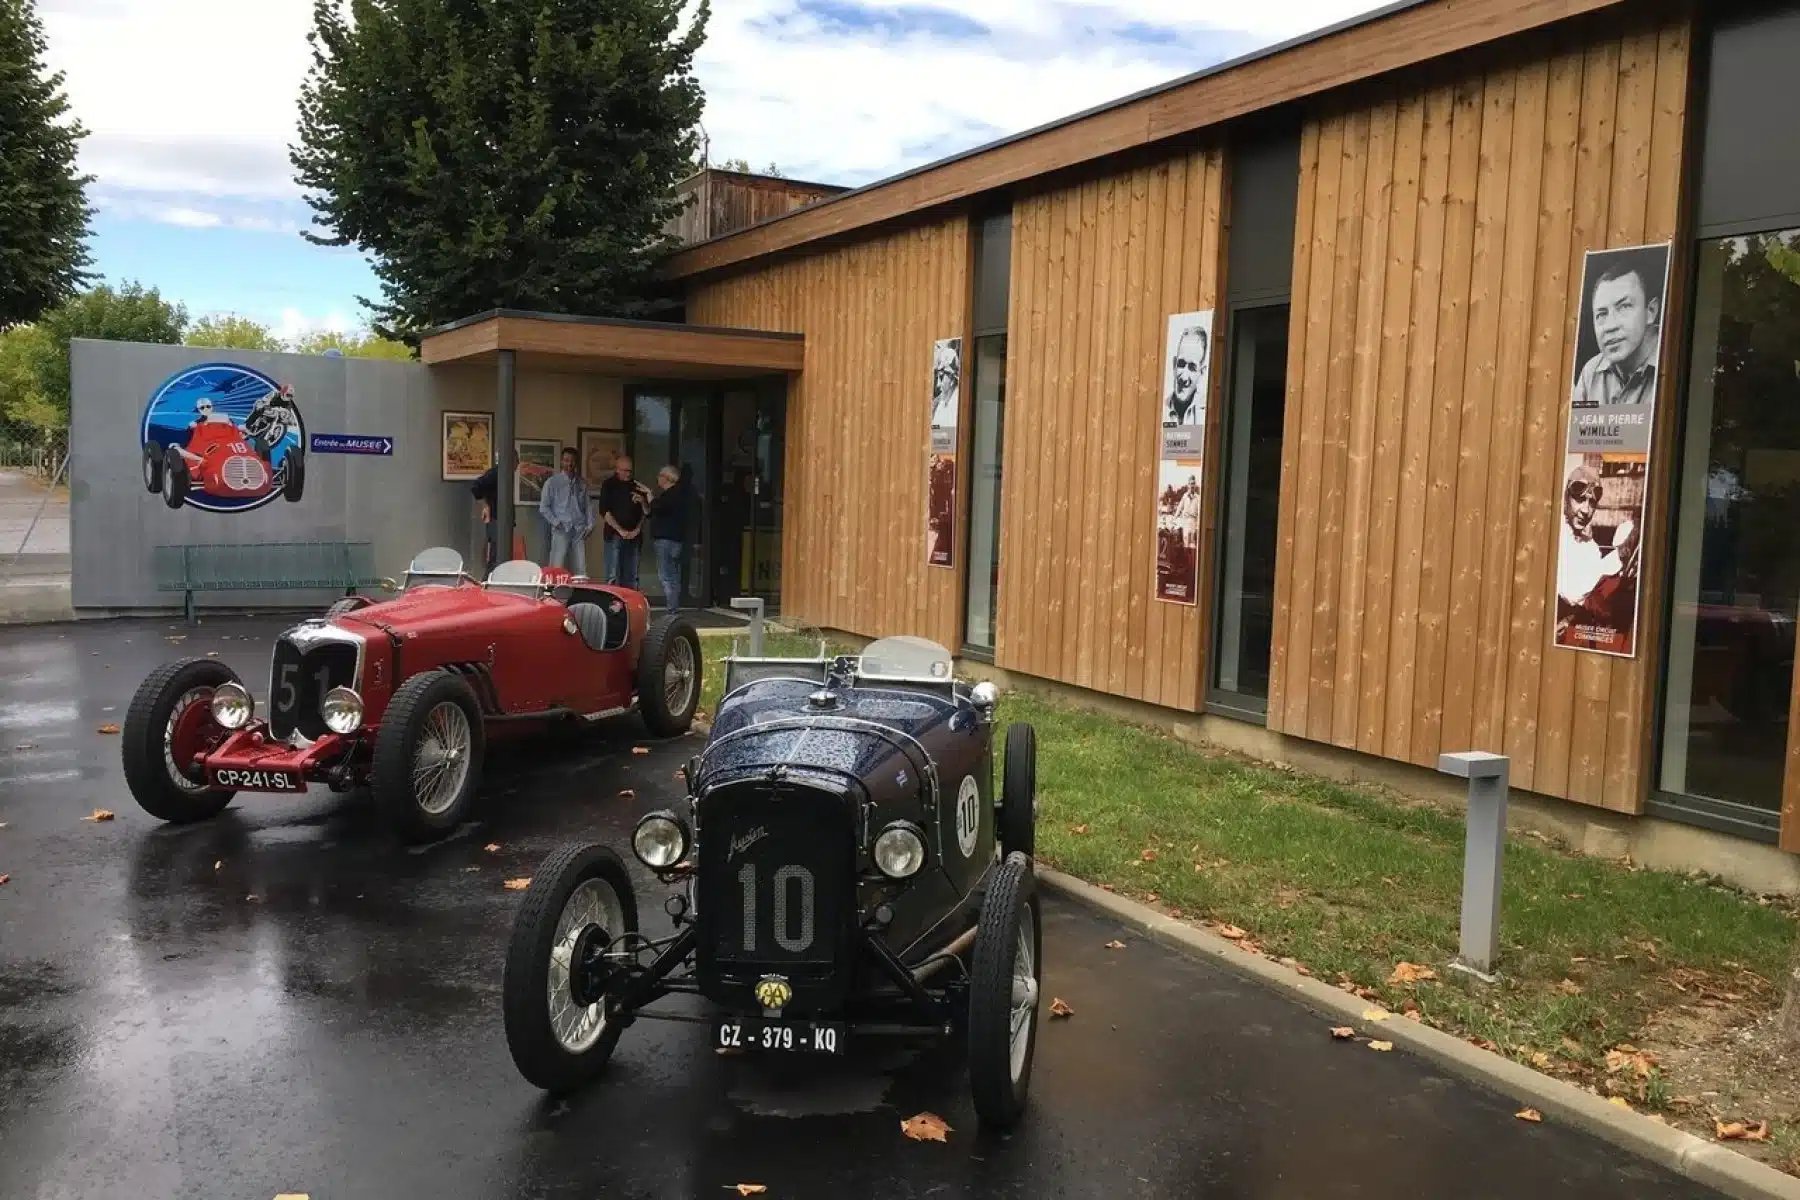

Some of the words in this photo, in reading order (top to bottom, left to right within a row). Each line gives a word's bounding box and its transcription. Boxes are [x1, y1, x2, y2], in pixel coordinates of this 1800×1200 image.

[1579, 414, 1604, 425] JEAN
[1608, 413, 1645, 425] PIERRE
[1579, 426, 1620, 437] WIMILLE
[226, 442, 247, 454] 18
[216, 769, 296, 789] CP-241-SL
[961, 793, 976, 838] 10
[737, 863, 815, 952] 10
[719, 1023, 742, 1047] CZ
[761, 1026, 793, 1049] 379
[814, 1027, 837, 1053] KQ
